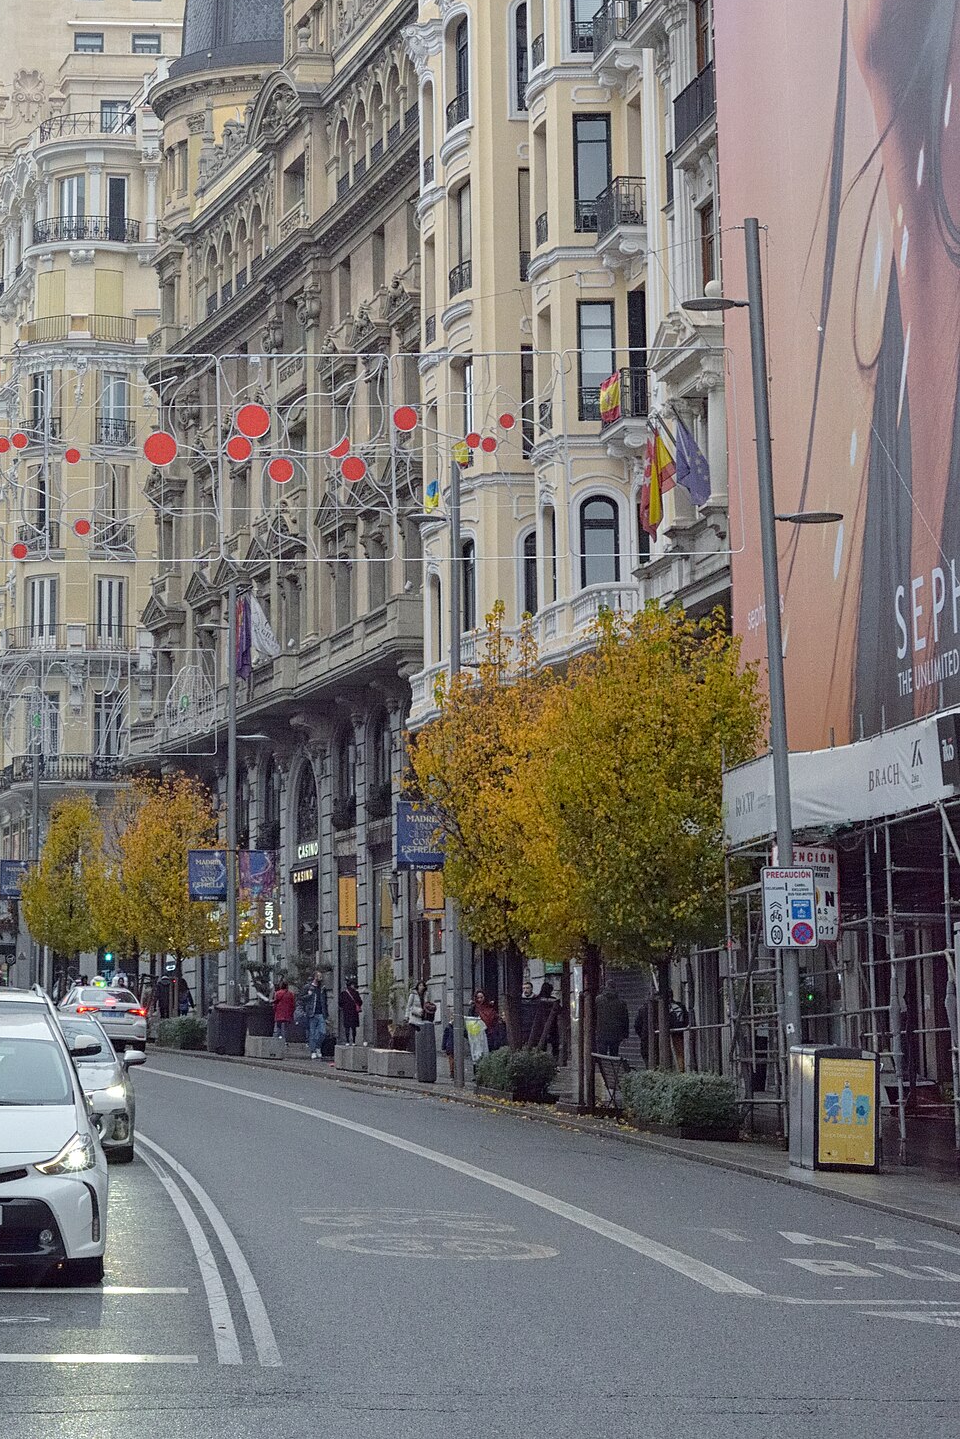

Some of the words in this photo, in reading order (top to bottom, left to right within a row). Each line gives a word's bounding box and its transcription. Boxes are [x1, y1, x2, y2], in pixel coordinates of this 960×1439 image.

[898, 668, 913, 697] THE
[914, 649, 960, 690] UNLIMITED
[868, 763, 900, 792] BRACH
[298, 842, 319, 859] CASINO
[793, 850, 835, 864] ENCIÓN
[293, 869, 313, 883] CASINO
[766, 870, 811, 879] PRECAUCIÓN
[265, 902, 273, 929] CASIN
